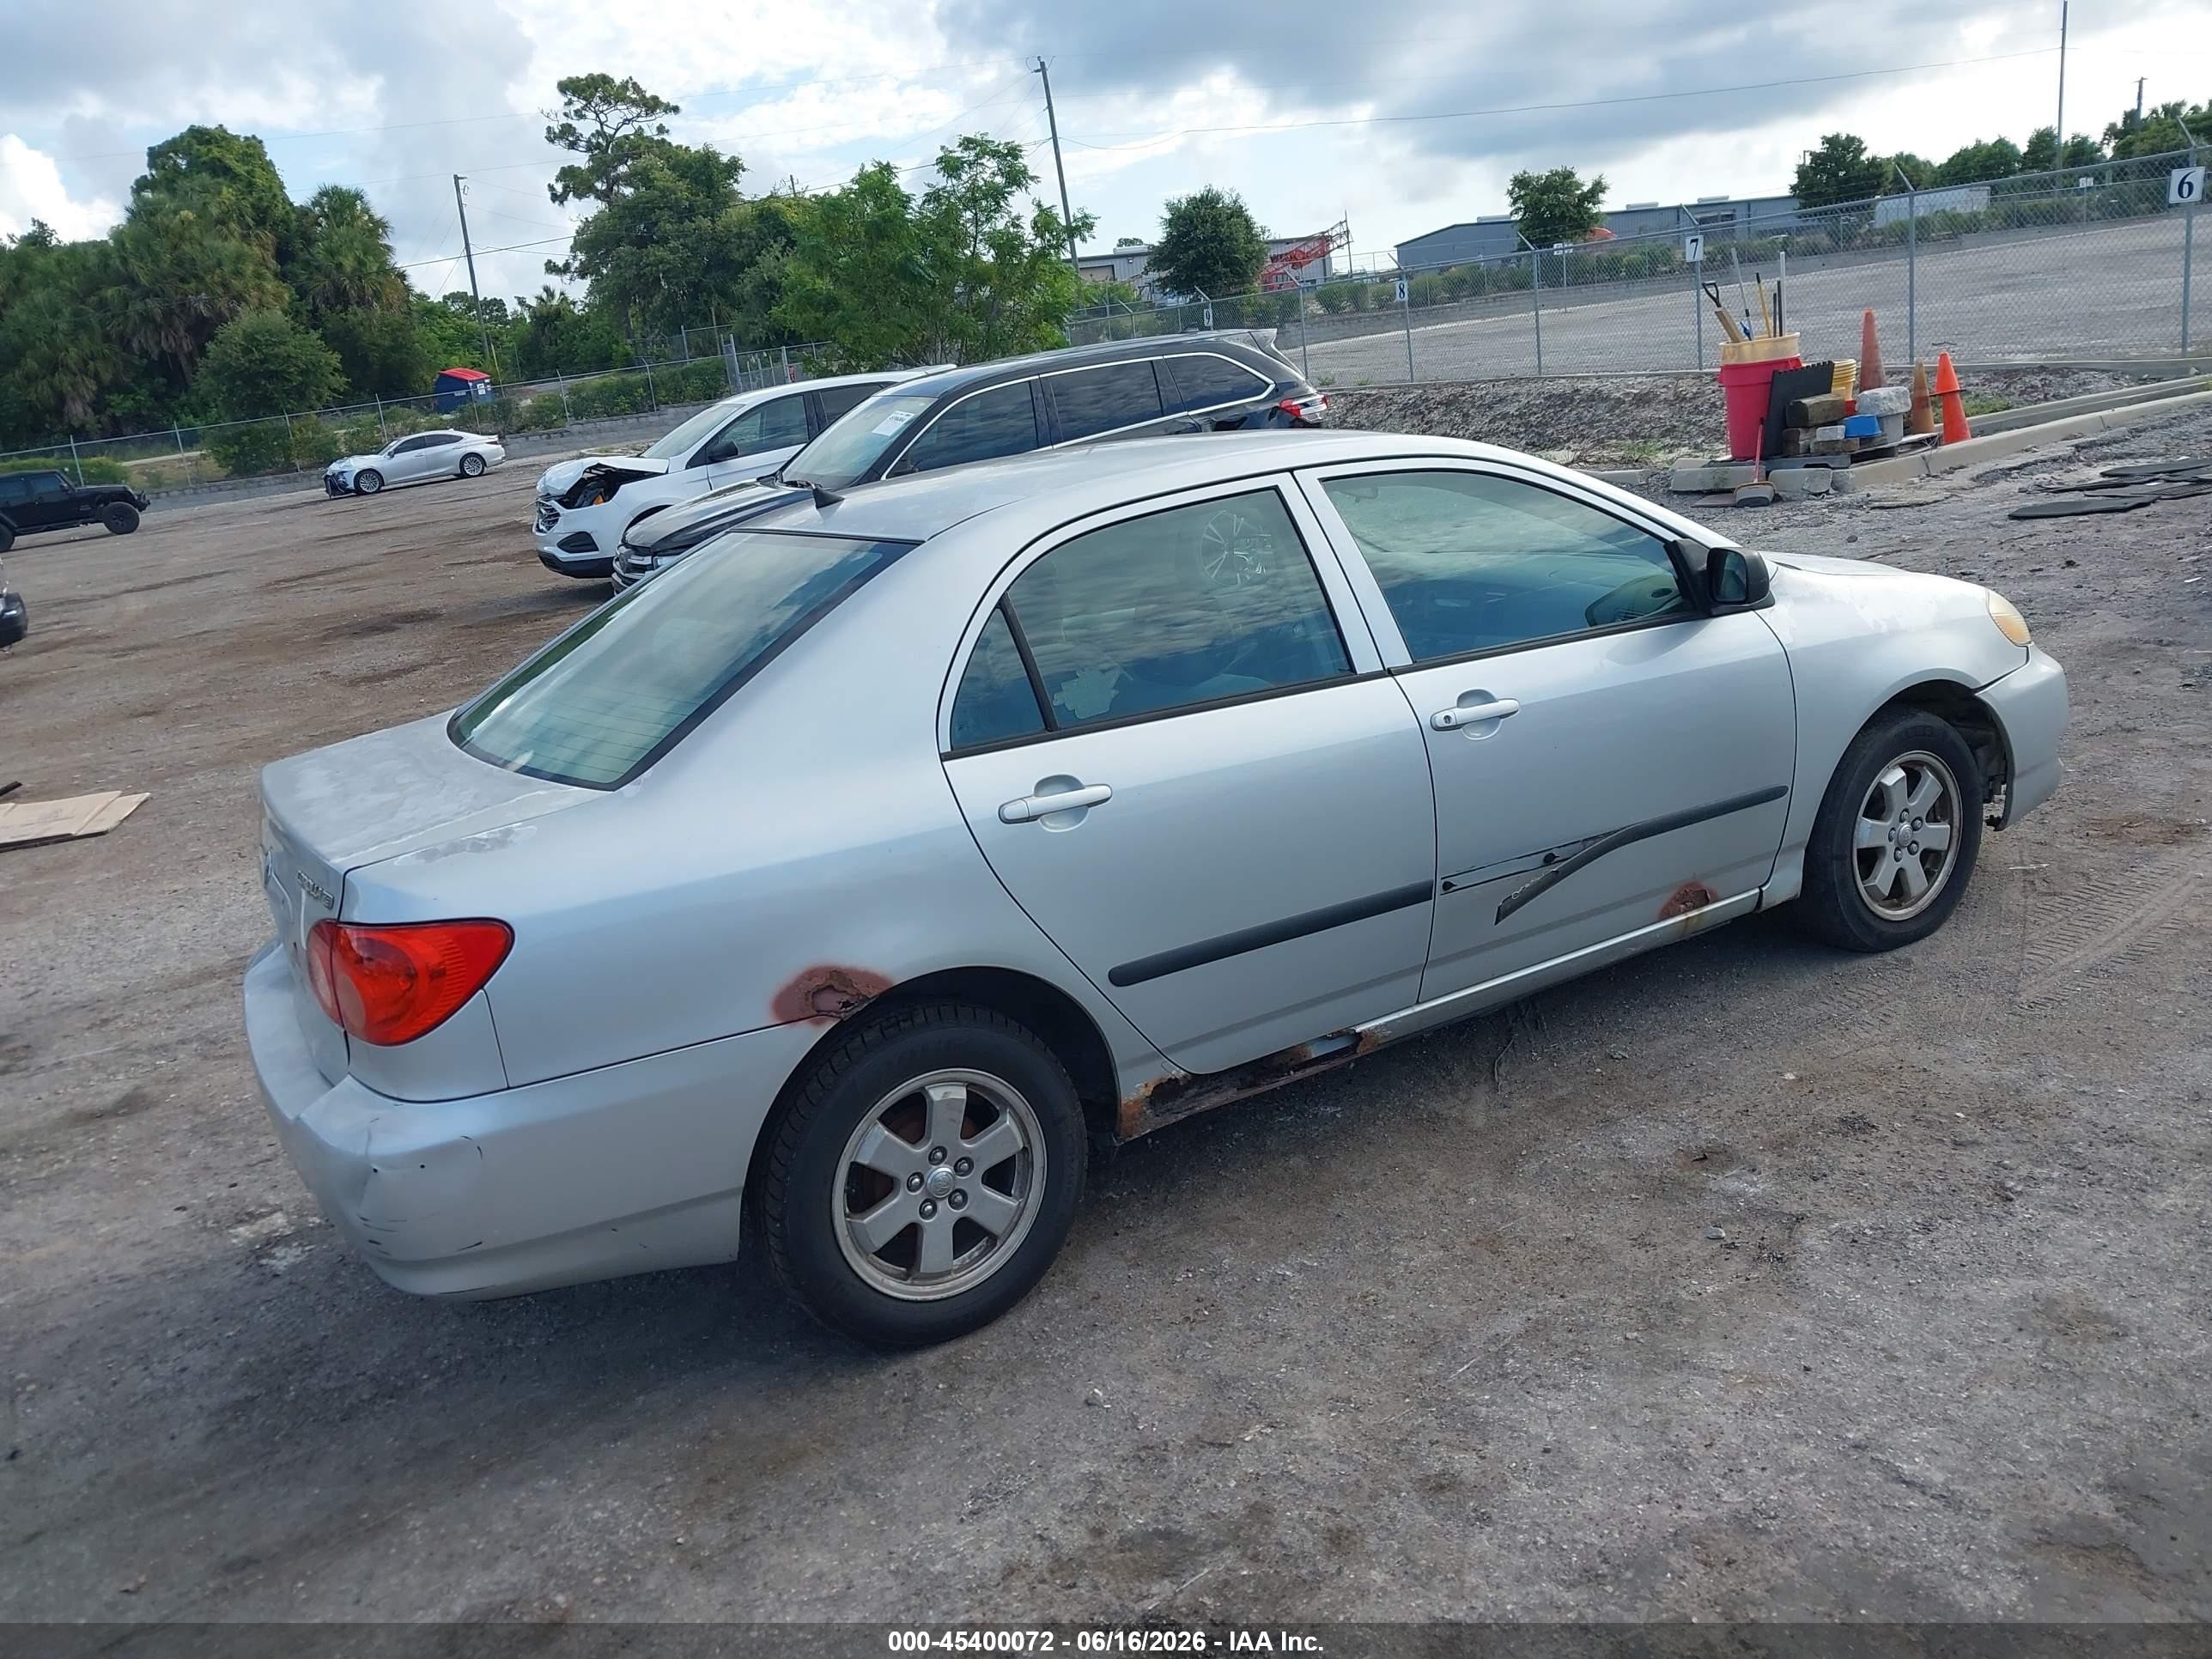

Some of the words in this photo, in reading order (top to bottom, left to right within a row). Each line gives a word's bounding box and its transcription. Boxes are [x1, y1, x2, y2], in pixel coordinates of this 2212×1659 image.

[2178, 170, 2196, 199] 6
[1689, 238, 1699, 260] 7
[1399, 283, 1406, 300] 8
[1205, 310, 1211, 325] 9
